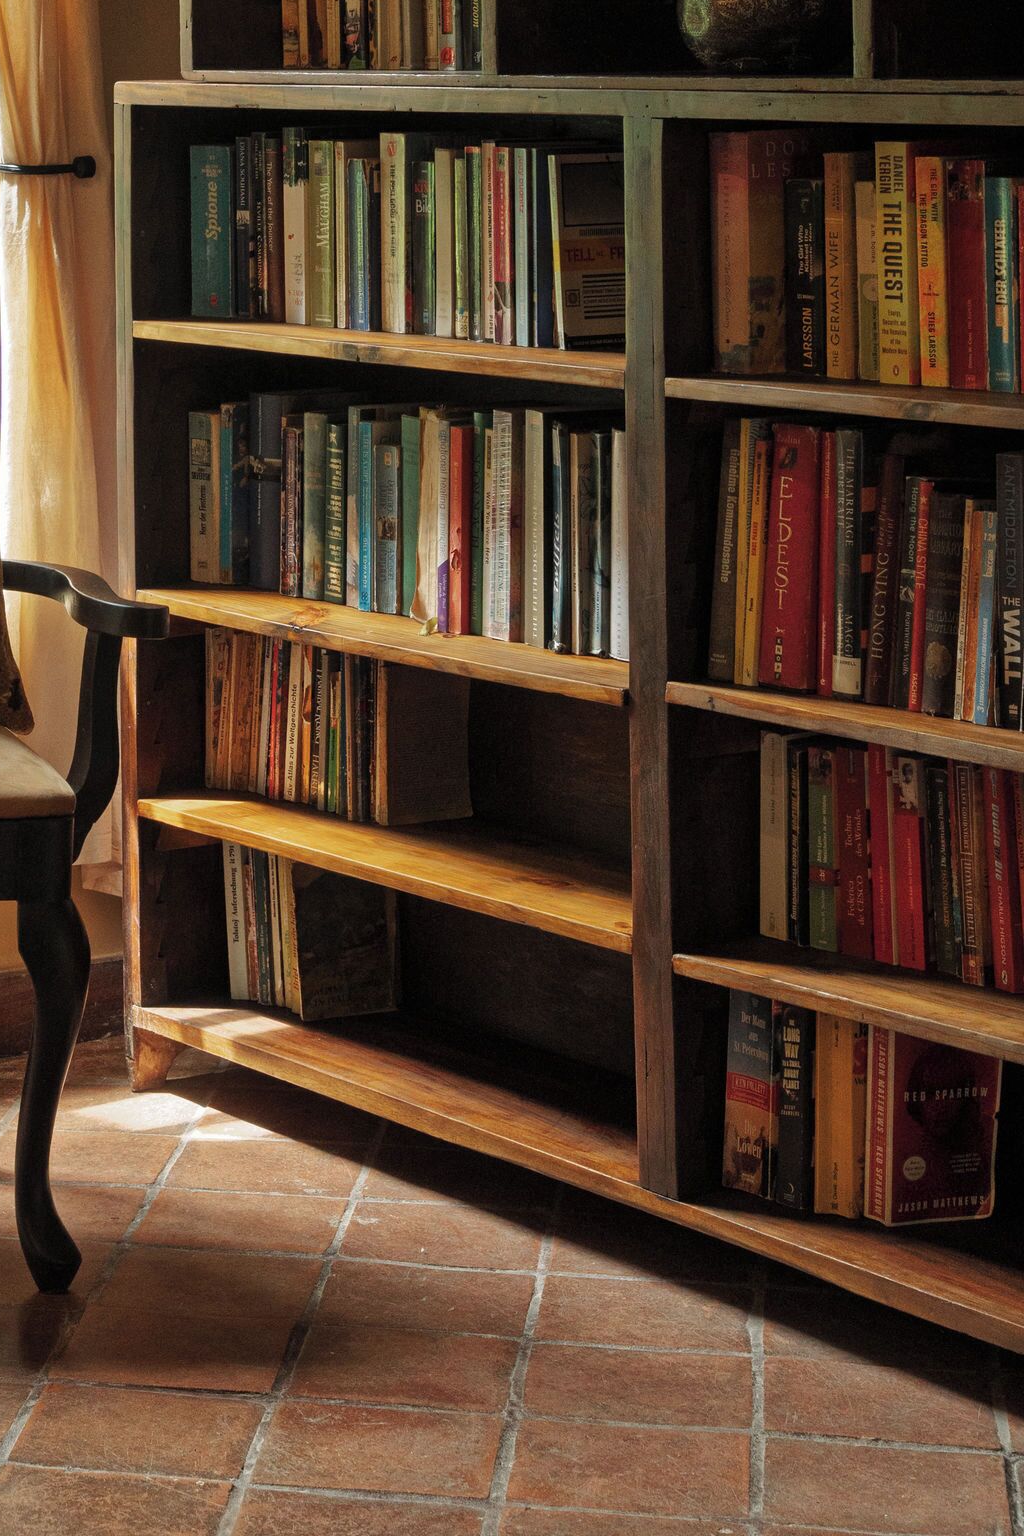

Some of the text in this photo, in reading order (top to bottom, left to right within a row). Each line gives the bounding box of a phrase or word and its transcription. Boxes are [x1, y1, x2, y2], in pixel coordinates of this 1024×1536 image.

[238, 140, 248, 207] DIANA SOUHAMI
[266, 161, 274, 177] The
[266, 177, 274, 196] Year
[879, 154, 892, 194] YERGIN
[892, 155, 904, 193] DANIEL
[930, 167, 939, 222] THE GIRL WITH
[204, 180, 223, 241] Spione
[267, 196, 274, 207] of
[316, 182, 330, 249] MAUGHAM
[797, 225, 805, 243] Who
[797, 244, 805, 259] Girl
[882, 201, 904, 303] THE QUEST
[919, 193, 929, 267] THE DRAGON TATTOO
[828, 231, 841, 368] THE GERMAN WIFE
[994, 280, 1008, 304] DER
[802, 307, 814, 368] LARSSON
[927, 311, 937, 368] STIEG LARSSON
[438, 429, 449, 509] emotional healing
[471, 454, 480, 548] BLACK ROCK
[484, 510, 492, 525] You
[844, 447, 856, 547] THE MARRIAGE
[720, 495, 737, 584] Kommandosache
[774, 475, 794, 610] ELDEST
[907, 487, 919, 563] Hang the Moon
[1005, 463, 1017, 588] ANT MIDDLETON
[531, 505, 539, 639] THE FIFTH DISCIPLINE
[915, 518, 929, 590] CHINA STYLE
[871, 552, 889, 660] HONG YING
[1001, 596, 1021, 607] THE
[844, 614, 856, 658] MAGGI
[901, 611, 912, 676] Jeannette Walls
[1002, 609, 1021, 685] WALL
[288, 684, 298, 745] Weltgeschichte
[911, 672, 919, 705] TASCHEN
[960, 786, 970, 805] LAST
[844, 815, 854, 848] Tochter
[853, 808, 863, 857] des Windes
[961, 806, 970, 850] GOODNIGHT
[991, 803, 1003, 881] Double Die
[228, 867, 239, 916] Auferstehung
[846, 880, 856, 917] Federica
[855, 875, 865, 926] de CESCO
[962, 860, 975, 944] HOWARD BLUM
[997, 885, 1007, 965] CHARLIE HIGSON
[740, 1010, 766, 1030] Der Mann
[783, 1026, 801, 1042] LONG
[784, 1042, 800, 1059] WAY
[743, 1079, 767, 1096] FOLLETT
[782, 1078, 800, 1090] PLANET
[903, 1086, 989, 1103] RED SPARROW
[873, 1043, 887, 1218] JASON MATTHEWS RED SPARROW
[897, 1194, 985, 1213] JASON MATTHEWS
